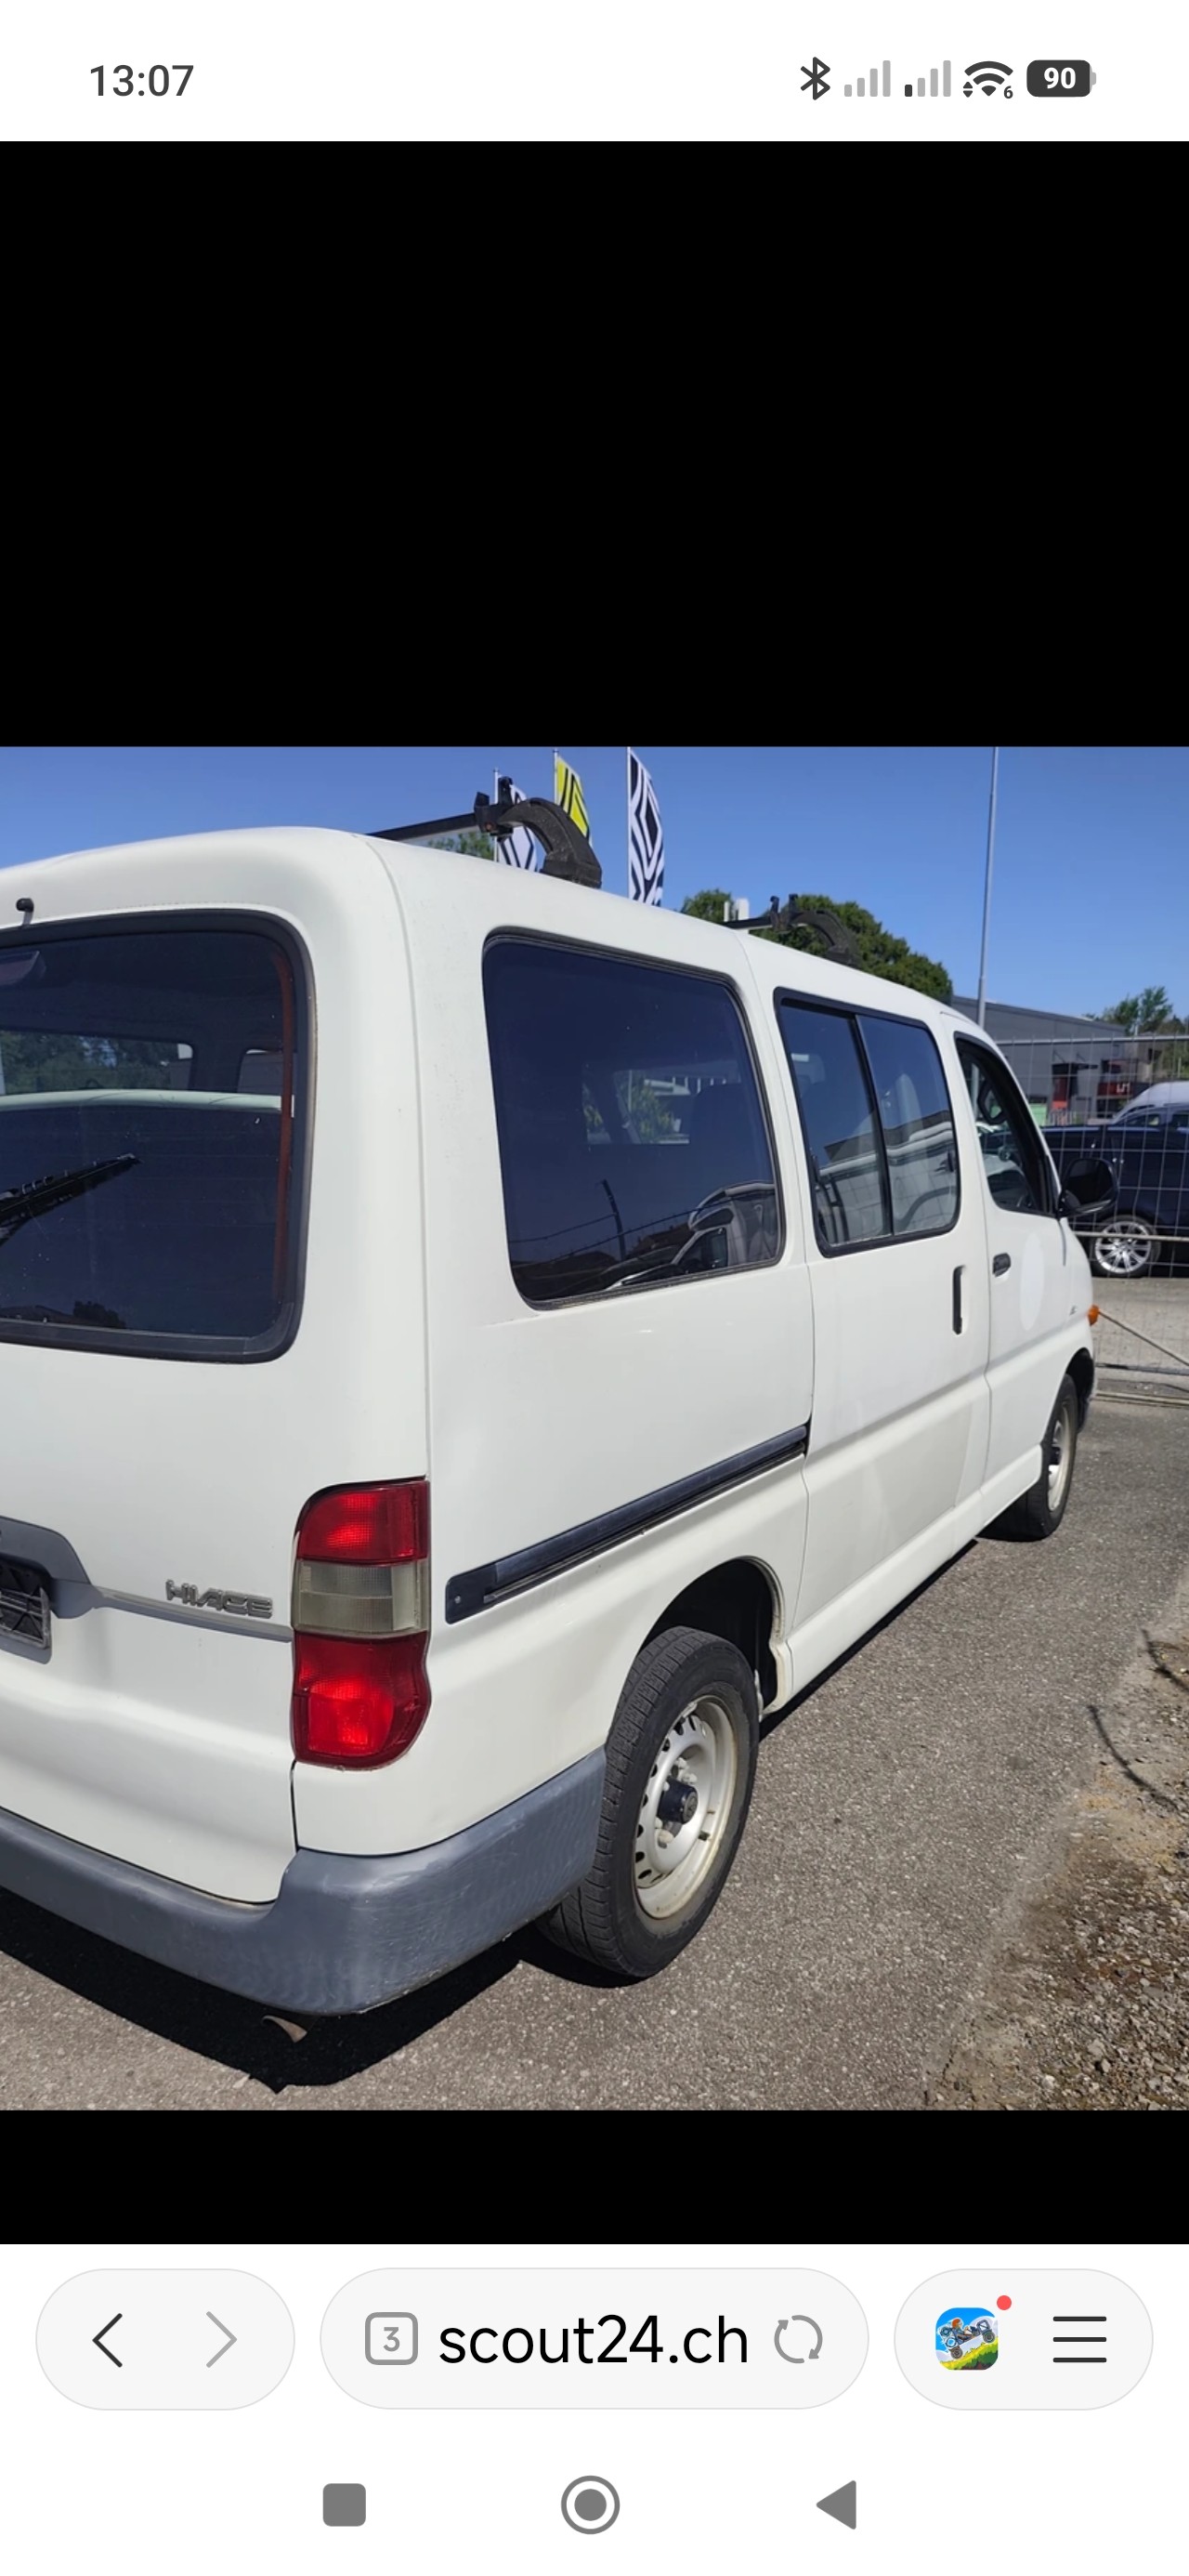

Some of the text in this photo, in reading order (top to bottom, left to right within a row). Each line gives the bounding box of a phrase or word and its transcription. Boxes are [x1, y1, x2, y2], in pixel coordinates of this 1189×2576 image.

[89, 64, 194, 97] 13:07
[1002, 85, 1014, 99] 6
[1043, 67, 1077, 90] 90
[165, 1579, 273, 1619] HIACE
[383, 2326, 401, 2352] 3
[438, 2314, 749, 2365] scout24.ch
